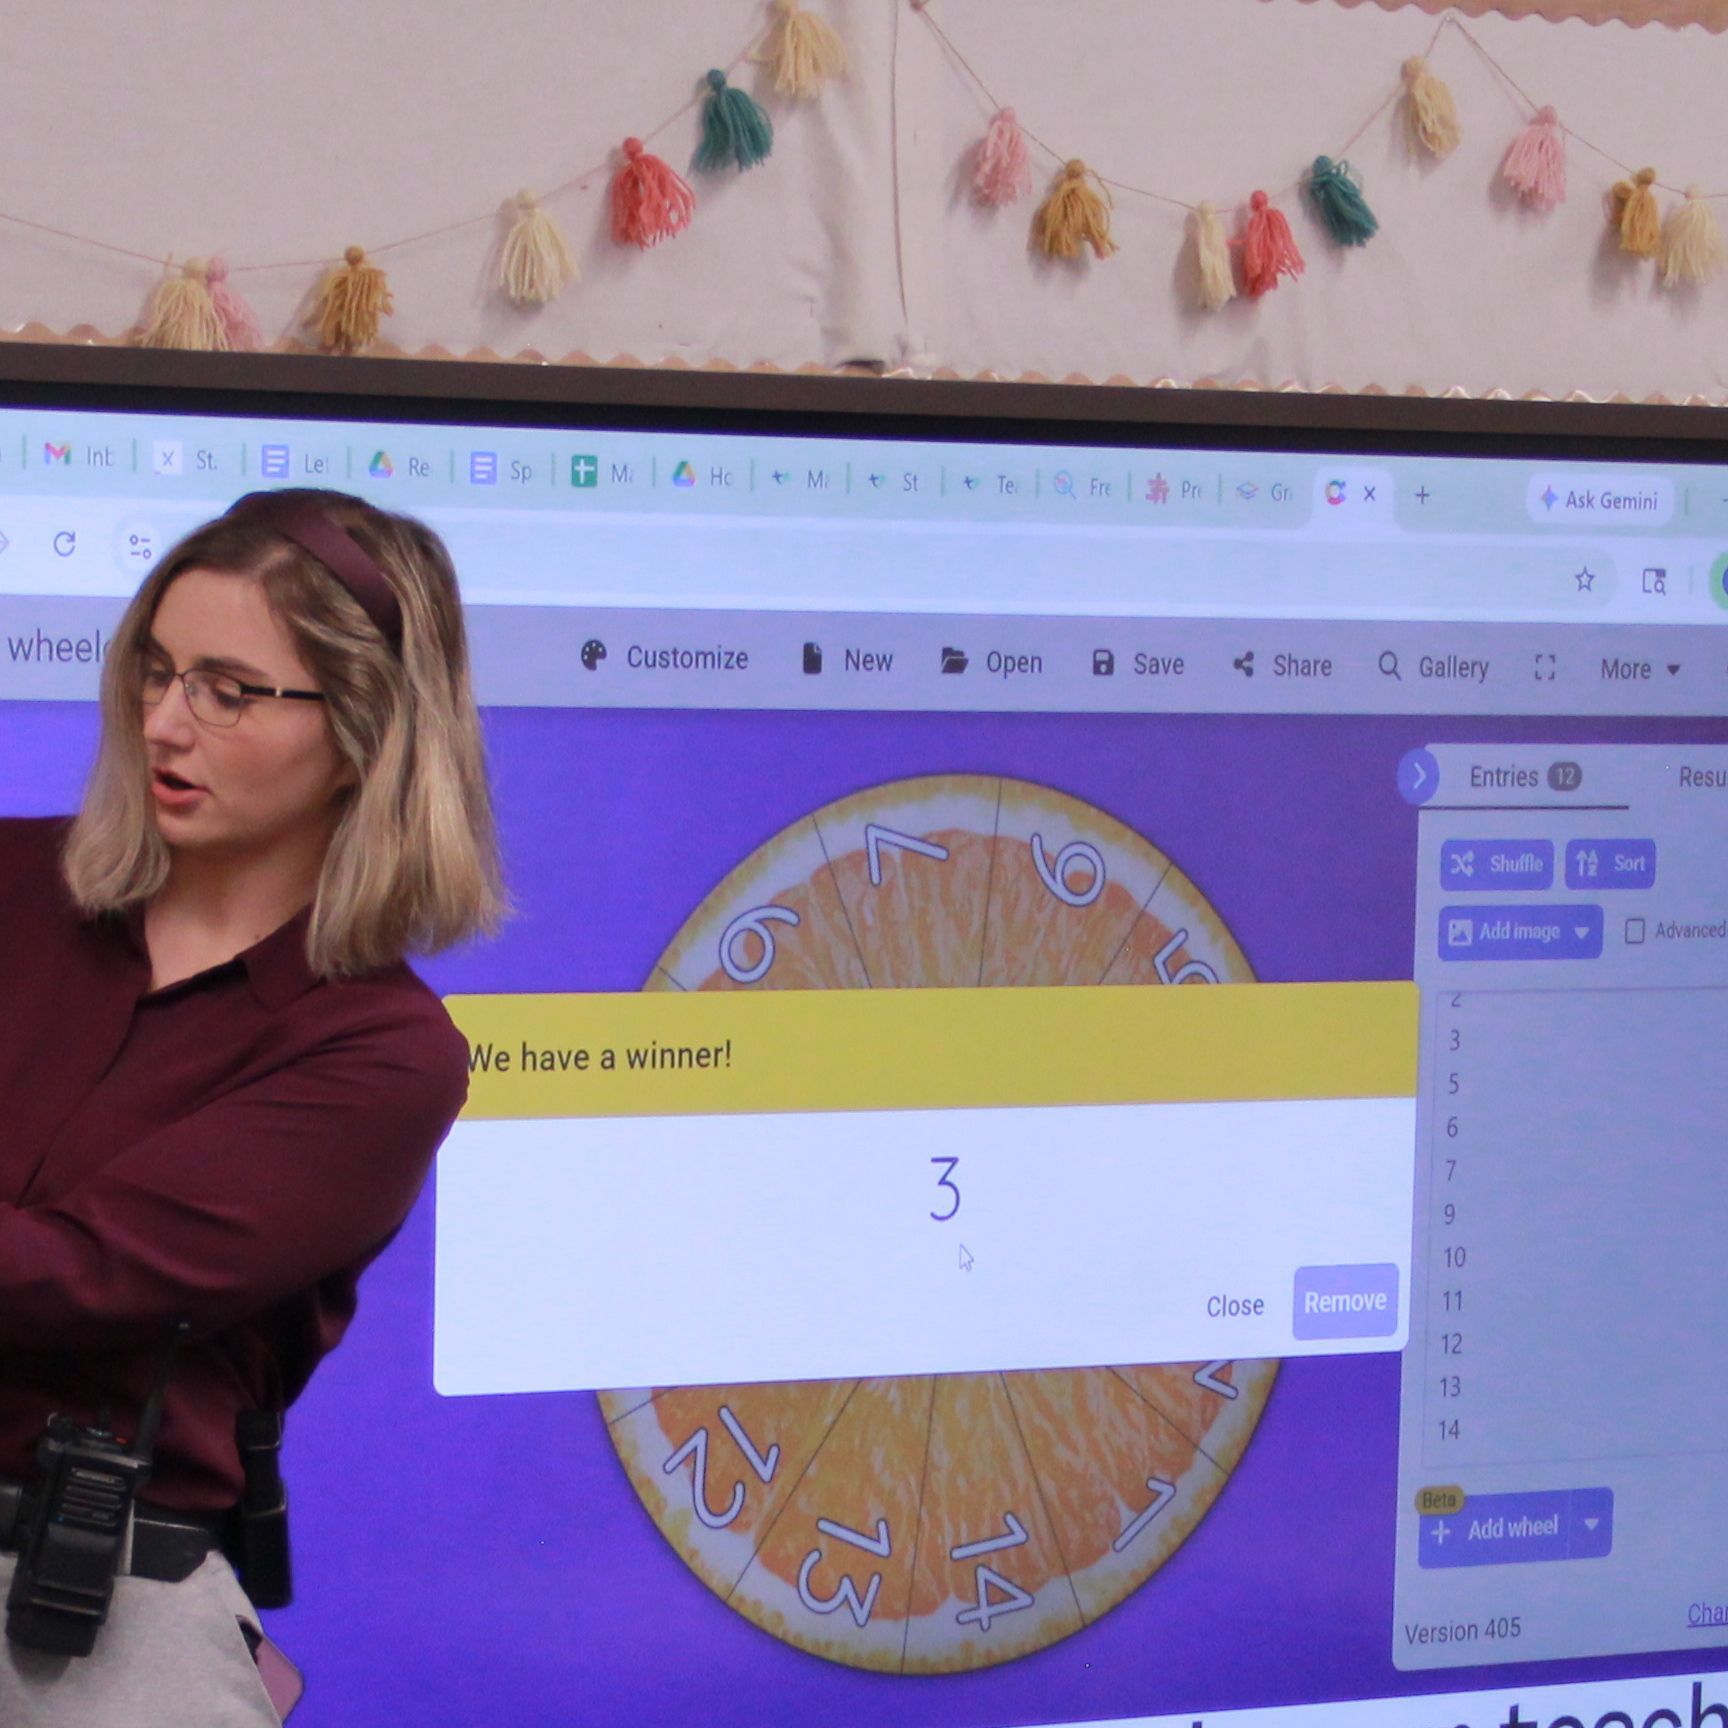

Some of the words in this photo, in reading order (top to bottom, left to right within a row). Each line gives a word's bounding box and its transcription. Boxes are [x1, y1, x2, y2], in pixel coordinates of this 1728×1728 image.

[1566, 489, 1596, 511] Ask
[1599, 490, 1659, 513] Gemini
[627, 643, 749, 672] Customize
[845, 648, 893, 673] New
[986, 650, 1043, 682] Open
[1134, 652, 1185, 676] Save
[1273, 654, 1333, 679] Share
[1419, 655, 1489, 686] Gallery
[1601, 658, 1652, 681] More
[1470, 765, 1539, 788] Entries
[1490, 852, 1544, 874] Shuffle
[1614, 853, 1646, 873] Sort
[1479, 922, 1511, 940] Add
[1514, 922, 1560, 944] image
[1655, 921, 1727, 939] Advanced
[1449, 1028, 1461, 1051] 3
[468, 1042, 511, 1073] We
[520, 1042, 590, 1072] have
[600, 1049, 616, 1071] a
[626, 1039, 733, 1070] winner!
[1448, 1072, 1459, 1095] 5
[1447, 1115, 1458, 1138] 6
[1446, 1159, 1457, 1182] 7
[929, 1155, 963, 1222] 3
[1444, 1203, 1455, 1225] 9
[1444, 1247, 1466, 1268] 10
[1206, 1293, 1265, 1318] Close
[1304, 1286, 1387, 1315] Remove
[1442, 1290, 1463, 1311] 11
[1441, 1334, 1463, 1355] 12
[1439, 1377, 1462, 1398] 13
[1438, 1419, 1460, 1440] 14
[1422, 1491, 1457, 1509] Beta
[1468, 1518, 1504, 1540] Add
[1508, 1514, 1559, 1538] wheel
[797, 1517, 892, 1628] 13
[949, 1511, 1035, 1631] 14
[1405, 1621, 1478, 1645] Version
[1485, 1618, 1522, 1640] 405
